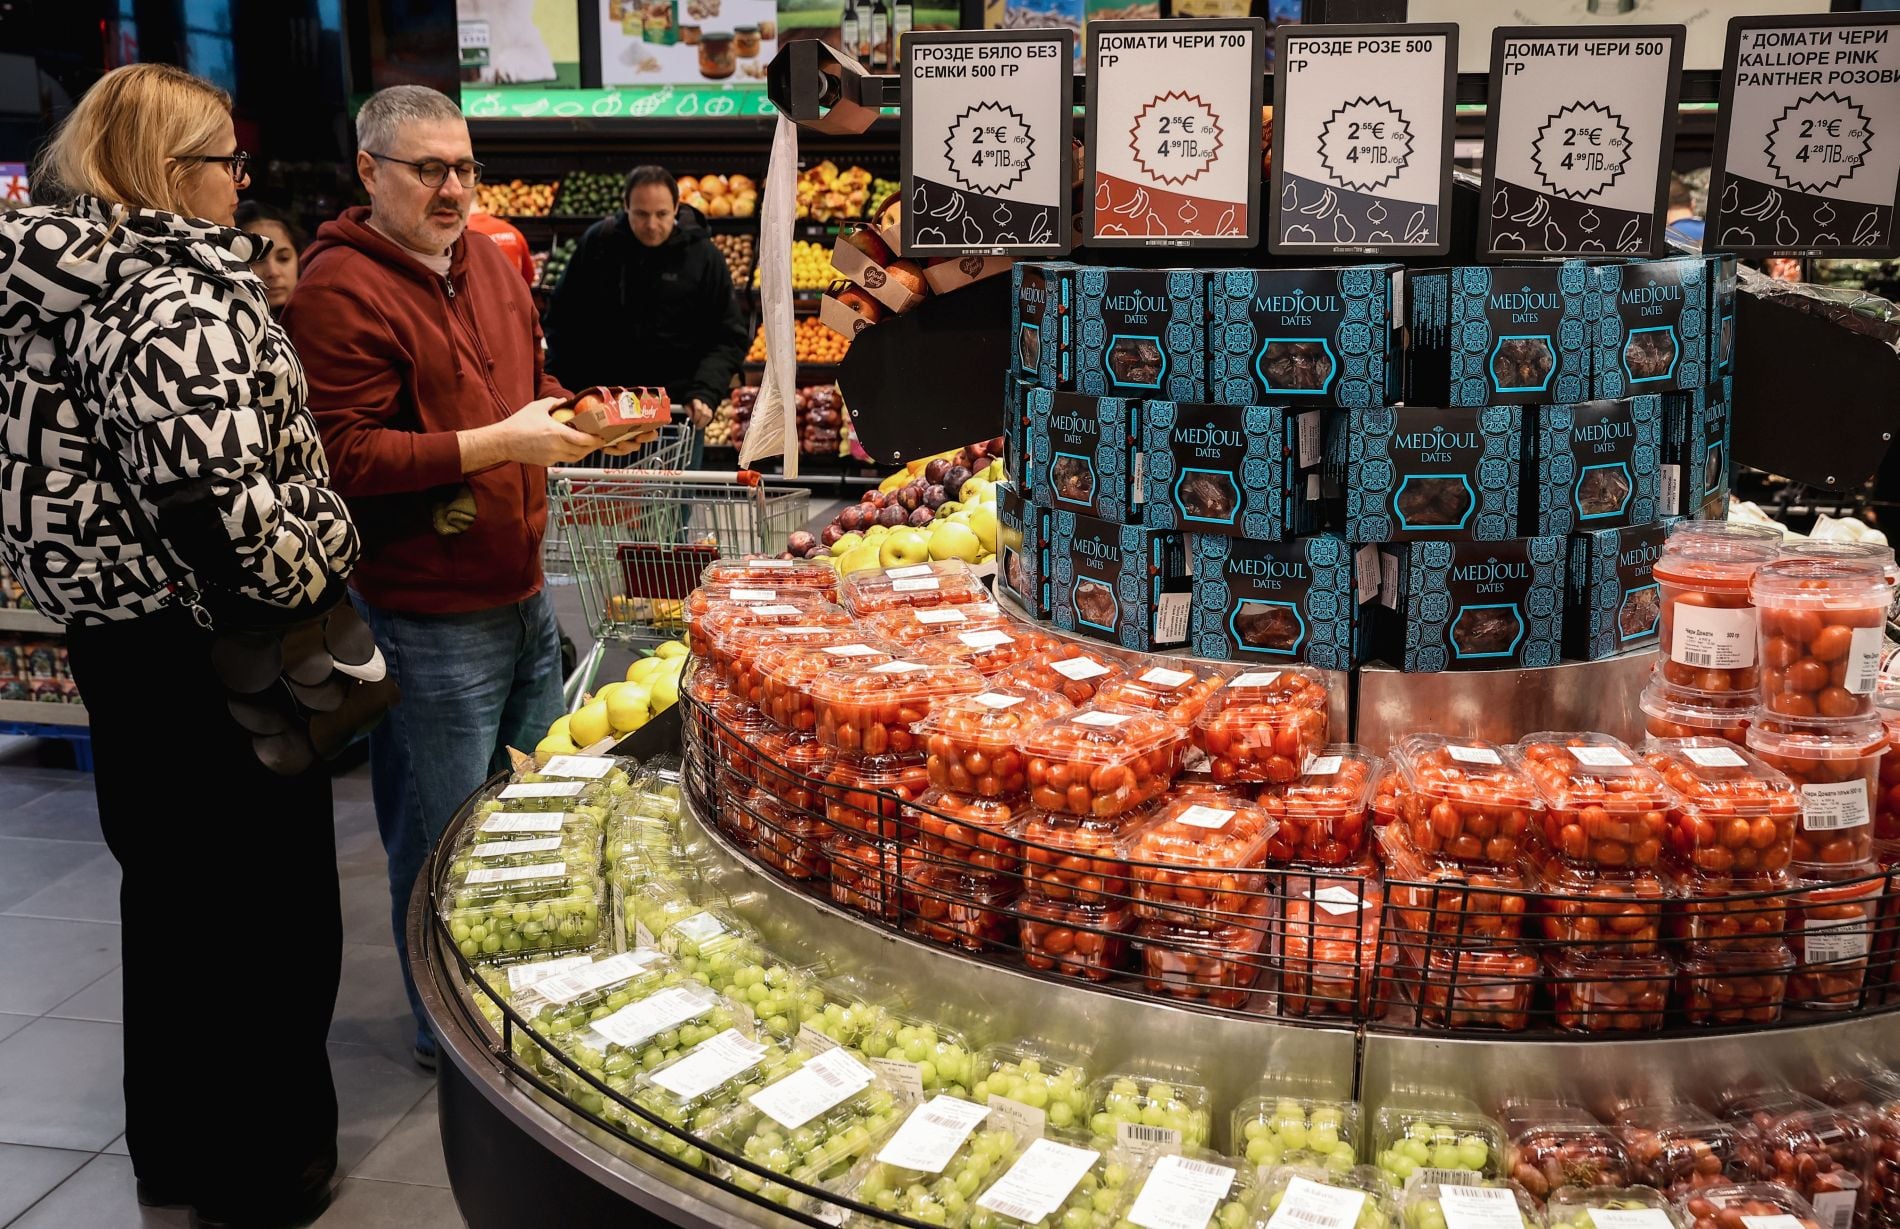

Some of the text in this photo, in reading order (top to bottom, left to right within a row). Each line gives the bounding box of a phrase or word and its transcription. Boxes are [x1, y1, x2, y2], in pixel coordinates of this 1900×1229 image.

[1099, 35, 1245, 52] ДОМАТИ ЧЕРИ 700
[1752, 31, 1832, 49] ДОМАТИ
[1838, 30, 1889, 45] ЧЕРИ
[914, 45, 1057, 62] ГРОЗДЕ БЯЛО БЕЗ
[1289, 40, 1432, 56] ГРОЗДЕ РОЗЕ 500
[1505, 42, 1664, 59] ДОМАТИ ЧЕРИ 500
[1100, 55, 1119, 67] ГР
[1289, 60, 1308, 72] ГР
[1739, 50, 1879, 67] KALLIOPE PINK
[914, 64, 1019, 78] СЕМКИ 500 ГР
[1504, 62, 1525, 75] ГР
[1737, 71, 1823, 87] PANTHER
[1490, 292, 1560, 312] MEDJOUL
[1621, 285, 1681, 306] MEDJOUL
[1105, 295, 1168, 315] MEDJOUL
[1255, 295, 1340, 316] MEDJOUL
[1641, 304, 1663, 316] DATES
[1124, 314, 1148, 324] DATES
[1281, 316, 1312, 326] DATES
[1512, 313, 1539, 323] DATES
[1050, 414, 1097, 435] MEDJOUL
[1574, 421, 1633, 443] MEDJOUL
[1064, 433, 1082, 445] DATES
[1174, 427, 1243, 448] MEDJOUL
[1395, 432, 1479, 451] MEDJOUL
[1195, 447, 1221, 459] DATES
[1593, 442, 1616, 454] DATES
[1421, 452, 1452, 463] DATES
[1073, 537, 1120, 563] MEDJOUL
[1086, 557, 1104, 570] DATES
[1229, 558, 1307, 580] MEDJOUL
[1452, 563, 1529, 584] MEDJOUL
[1253, 578, 1282, 590] DATES
[1476, 582, 1505, 593] DATES
